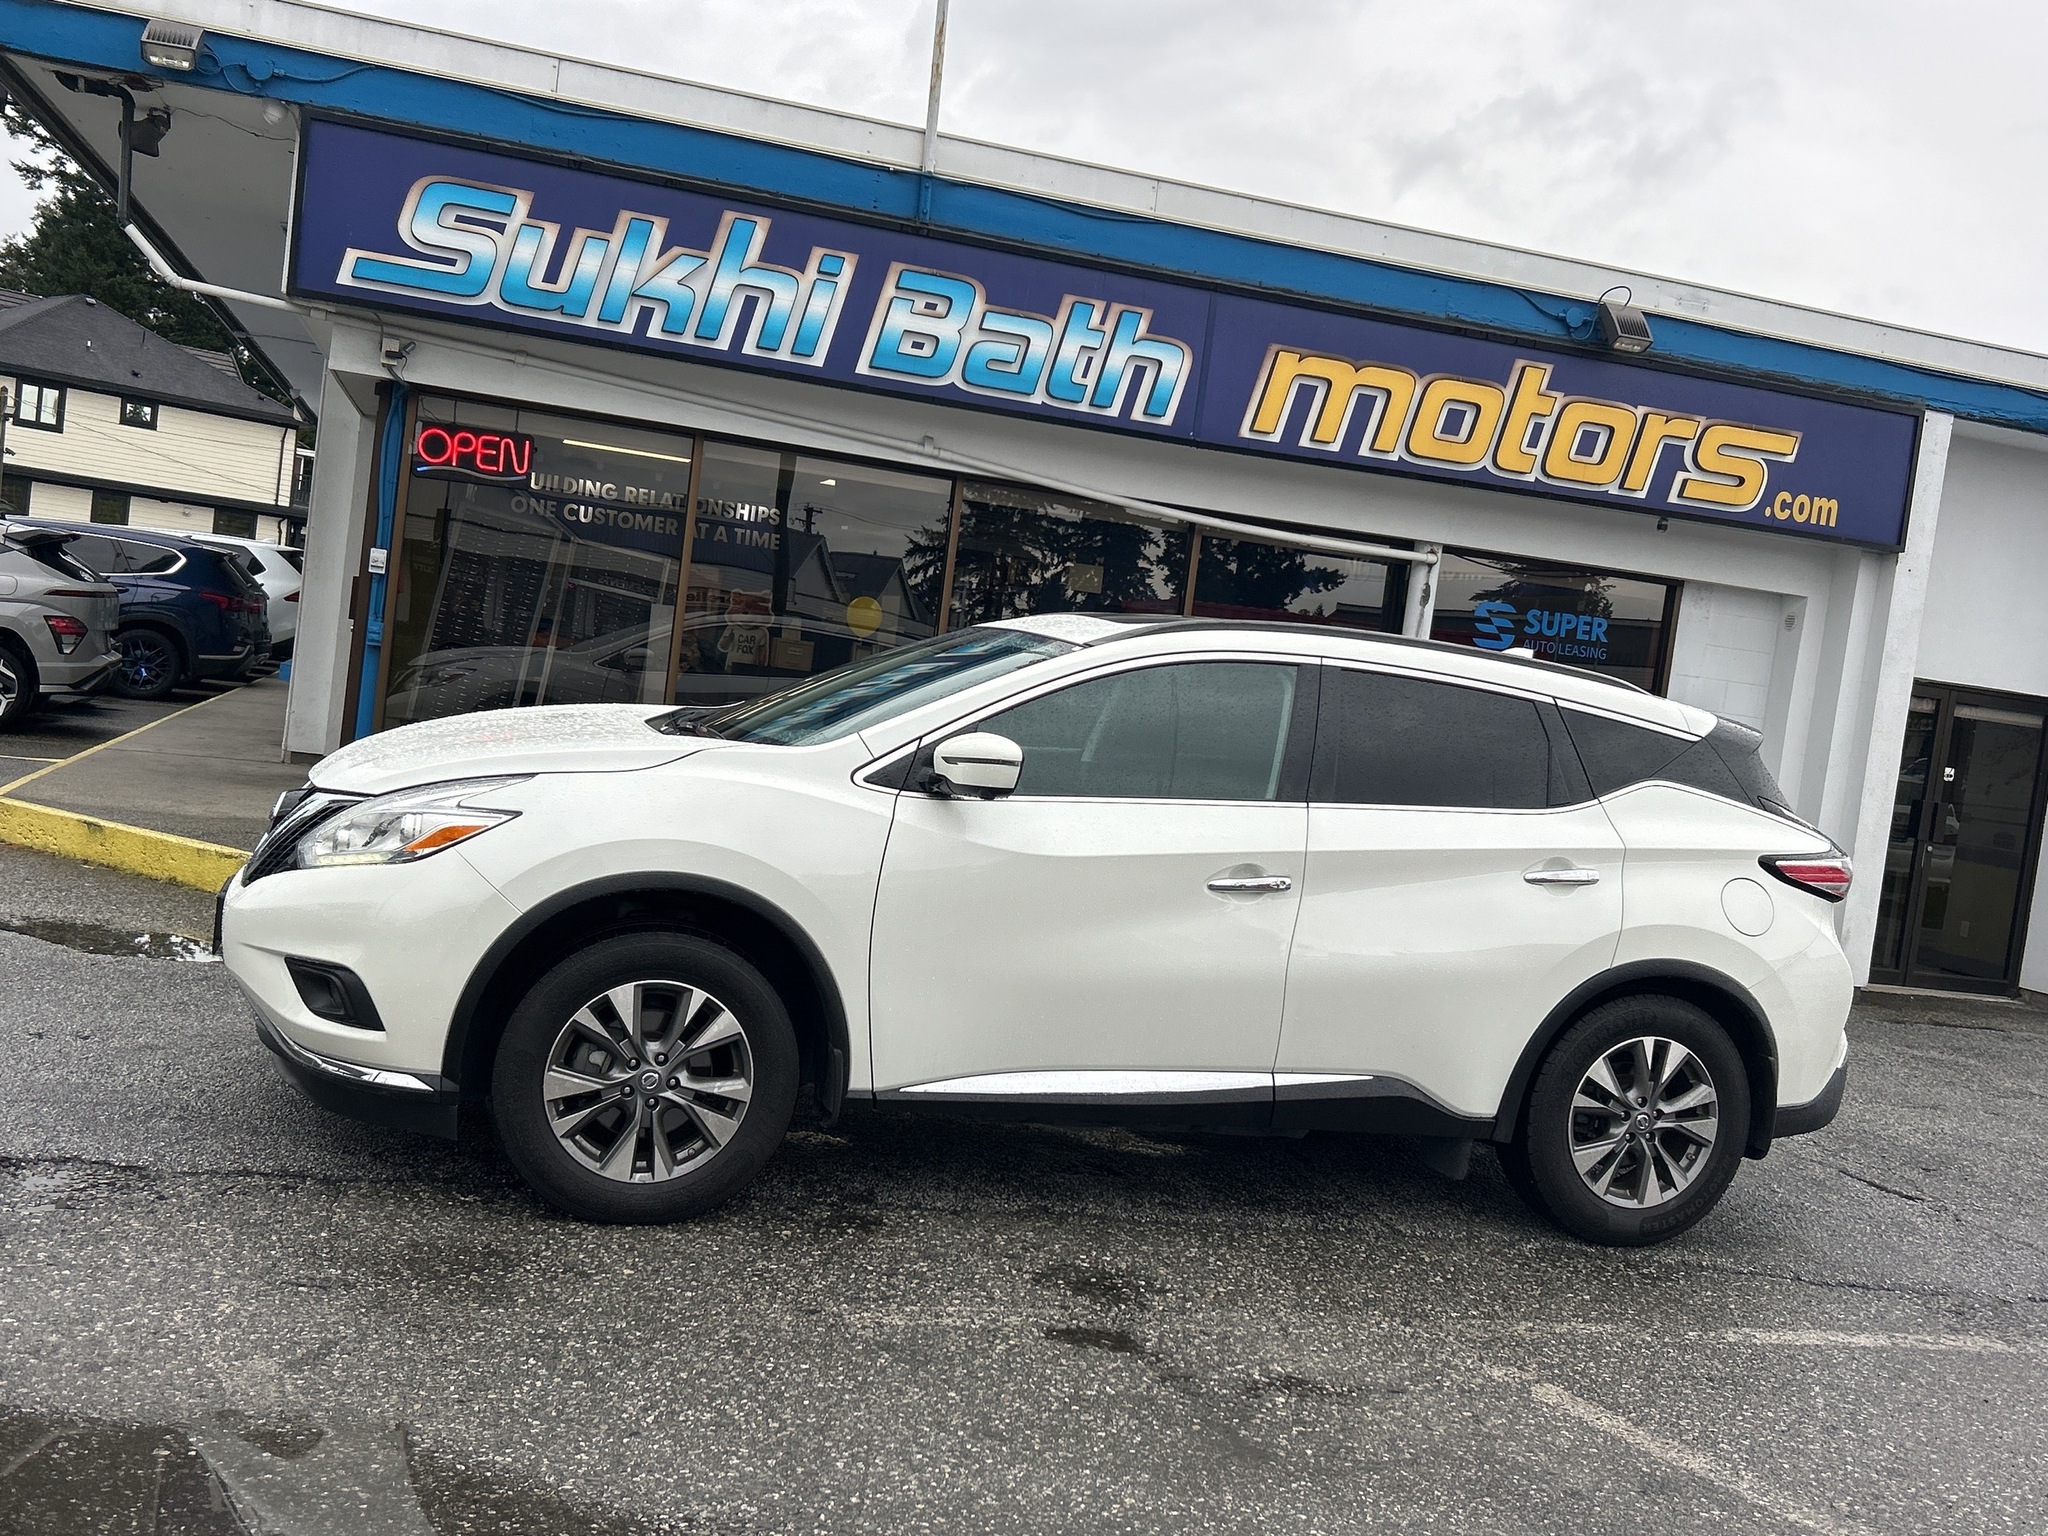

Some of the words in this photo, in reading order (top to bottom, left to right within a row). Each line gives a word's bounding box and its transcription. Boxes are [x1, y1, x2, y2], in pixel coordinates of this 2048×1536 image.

[336, 175, 858, 367] Sukhi
[856, 261, 1193, 426] Bath
[1239, 343, 1802, 512] motors
[418, 427, 531, 475] OPEN
[530, 471, 618, 500] UILDING
[624, 486, 781, 526] RELATONSHIPS
[510, 495, 557, 517] ONE
[563, 503, 679, 537] CUSTOMER
[713, 525, 728, 543] A
[734, 527, 781, 551] TIME
[738, 633, 757, 646] CAR
[1523, 608, 1609, 643] SUPER
[737, 644, 756, 655] FOX
[1523, 639, 1556, 655] AUTO
[1557, 643, 1607, 661] LEASING
